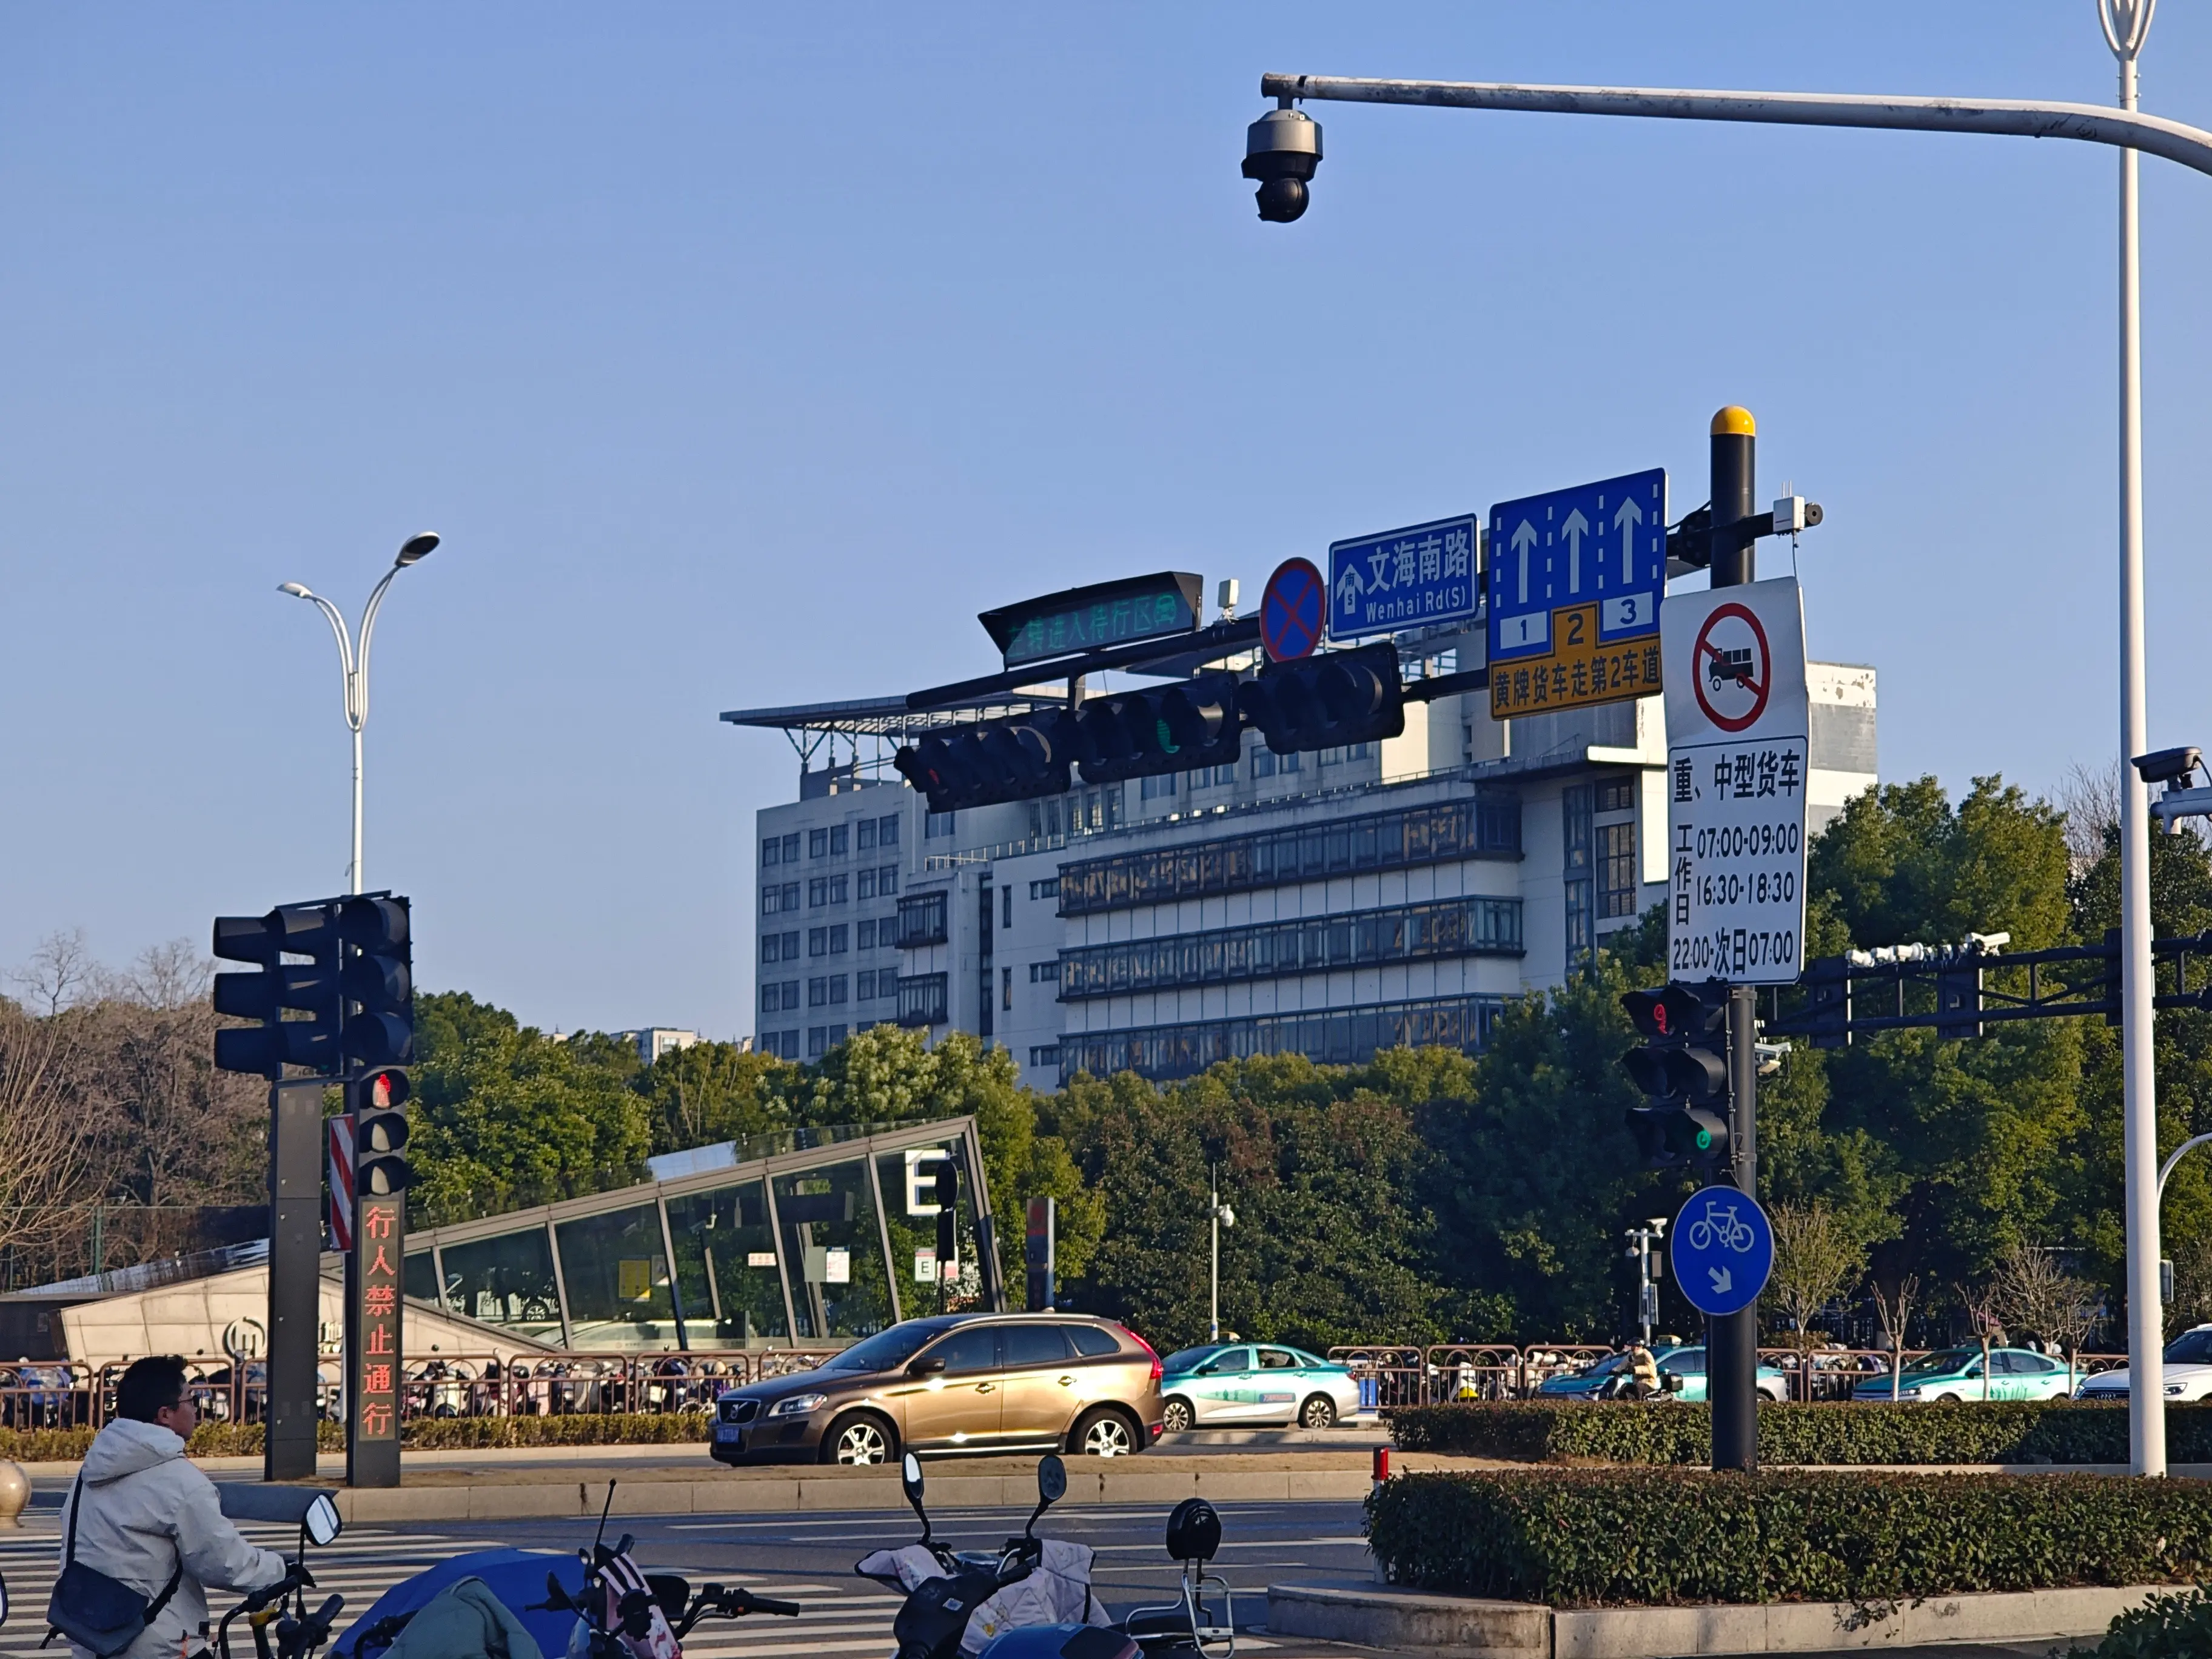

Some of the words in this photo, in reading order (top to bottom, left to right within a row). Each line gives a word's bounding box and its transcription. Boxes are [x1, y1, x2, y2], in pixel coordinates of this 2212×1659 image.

[1346, 572, 1354, 587] 南
[1366, 529, 1469, 595] 文海南路
[1347, 594, 1353, 606] S
[1366, 592, 1419, 623] Wenhai
[1426, 586, 1466, 612] Rd(S)
[1620, 598, 1637, 625] 3
[1520, 619, 1527, 641] 1
[1567, 613, 1584, 645] 2
[1495, 646, 1660, 709] 黄牌货车走第2车道
[1697, 822, 1798, 859] 07:00-09:00
[1675, 824, 1692, 925] 工作日
[1697, 871, 1794, 906] 16:30-18:30
[1674, 927, 1793, 975] 22:00-次日07:00
[905, 1149, 950, 1215] E
[921, 1261, 929, 1273] E
[362, 1207, 396, 1435] 行人禁止通行
